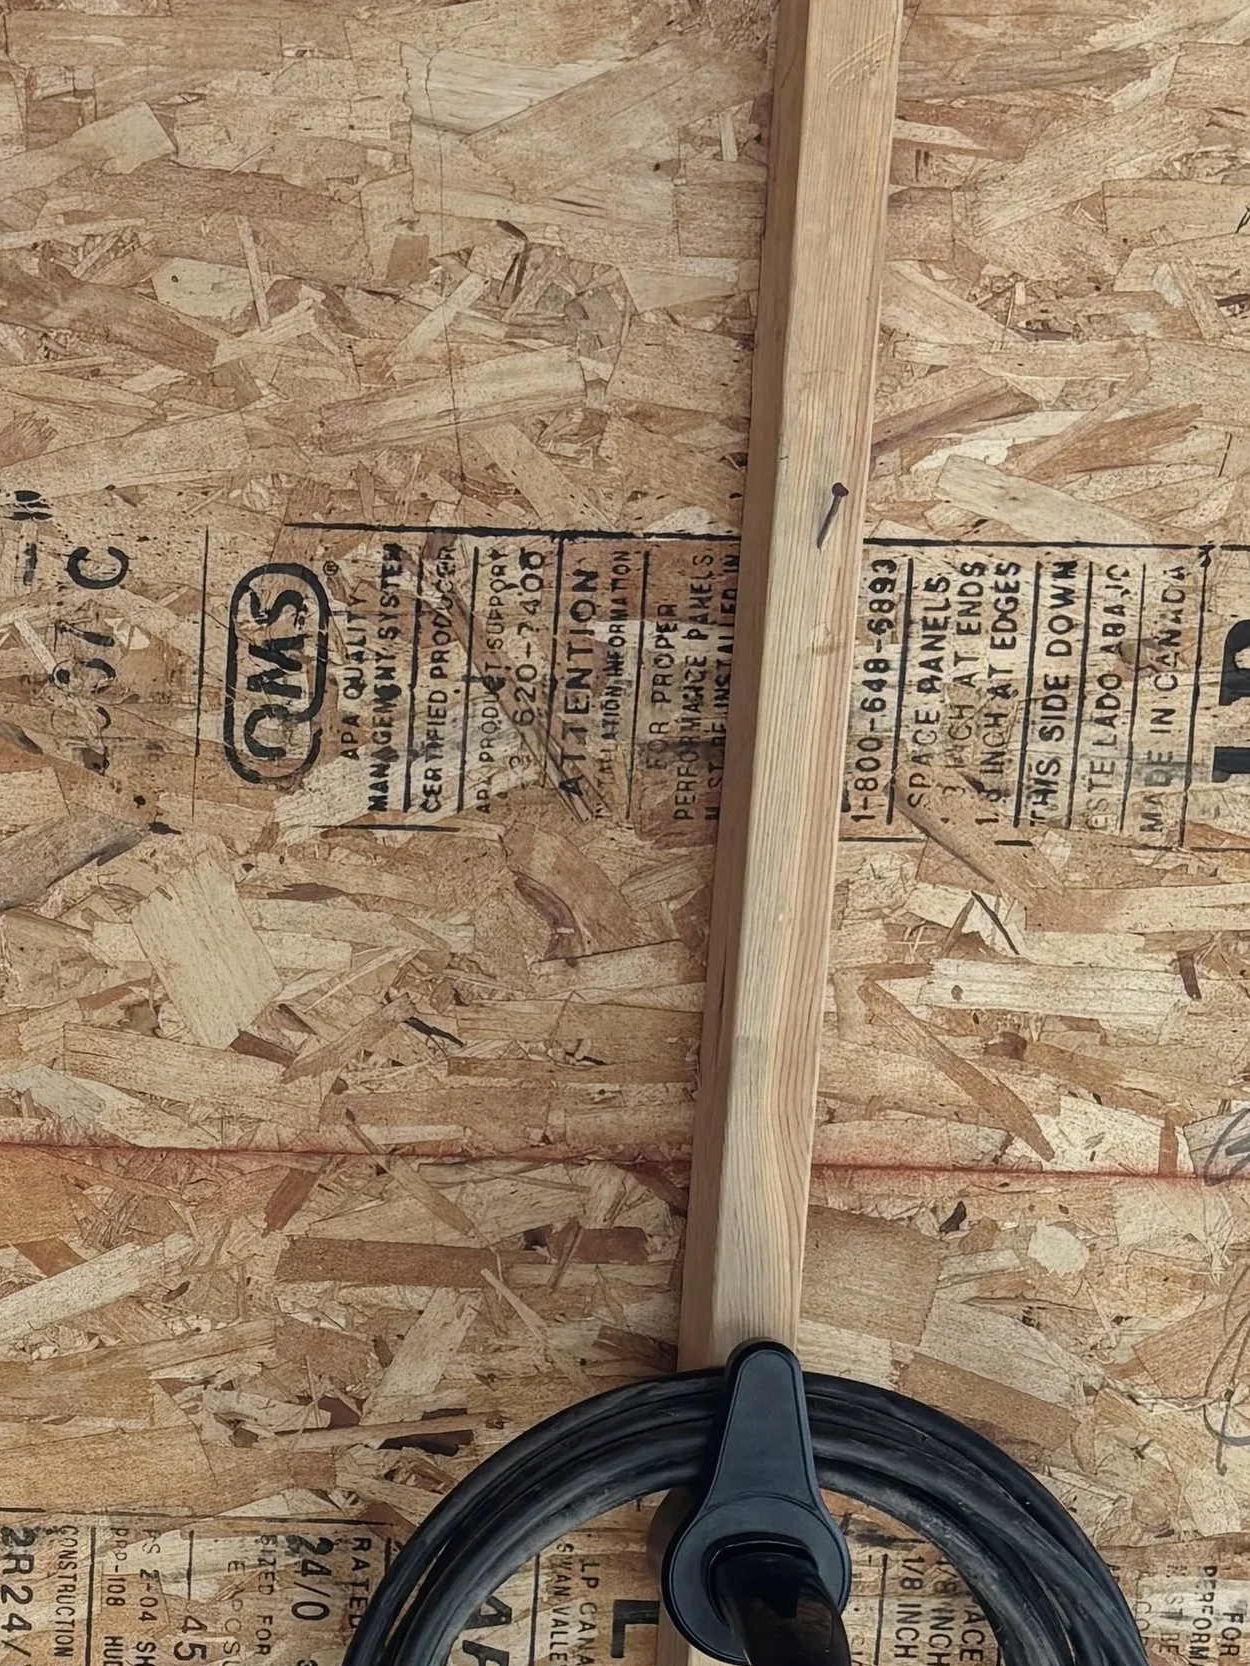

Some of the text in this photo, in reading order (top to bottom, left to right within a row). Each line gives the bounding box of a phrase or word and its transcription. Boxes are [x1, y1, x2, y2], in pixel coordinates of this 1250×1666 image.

[377, 542, 404, 640] SYSTEM
[602, 550, 633, 678] INFORMATION
[955, 560, 989, 636] ENDS
[341, 592, 368, 760] APA QUALITY
[420, 546, 456, 813] CERTIFIED PRODUCER
[558, 567, 600, 797] ATTENTION
[646, 603, 679, 770] FOR PROPER
[673, 554, 715, 820] PERFORMANCE PANELS
[952, 651, 981, 689] AT
[979, 560, 1022, 775] INCH AT EDGES
[1029, 559, 1079, 828] THIS SIDE DOWN
[1091, 672, 1123, 747] LADO
[1139, 564, 1187, 834] MADE IN CANADA
[907, 708, 941, 809] SPACE
[105, 1526, 130, 1609] PRP-108
[140, 1528, 161, 1555] PS
[348, 1536, 372, 1631] RATED
[551, 1542, 575, 1598] SWAN
[579, 1558, 601, 1590] LP
[900, 1554, 925, 1591] 1/8
[54, 1525, 80, 1658] CONSTRUCTION
[254, 1614, 274, 1657] FOR
[893, 1602, 922, 1660] INCH
[926, 1604, 953, 1666] INCH
[1219, 1610, 1244, 1657] FOR
